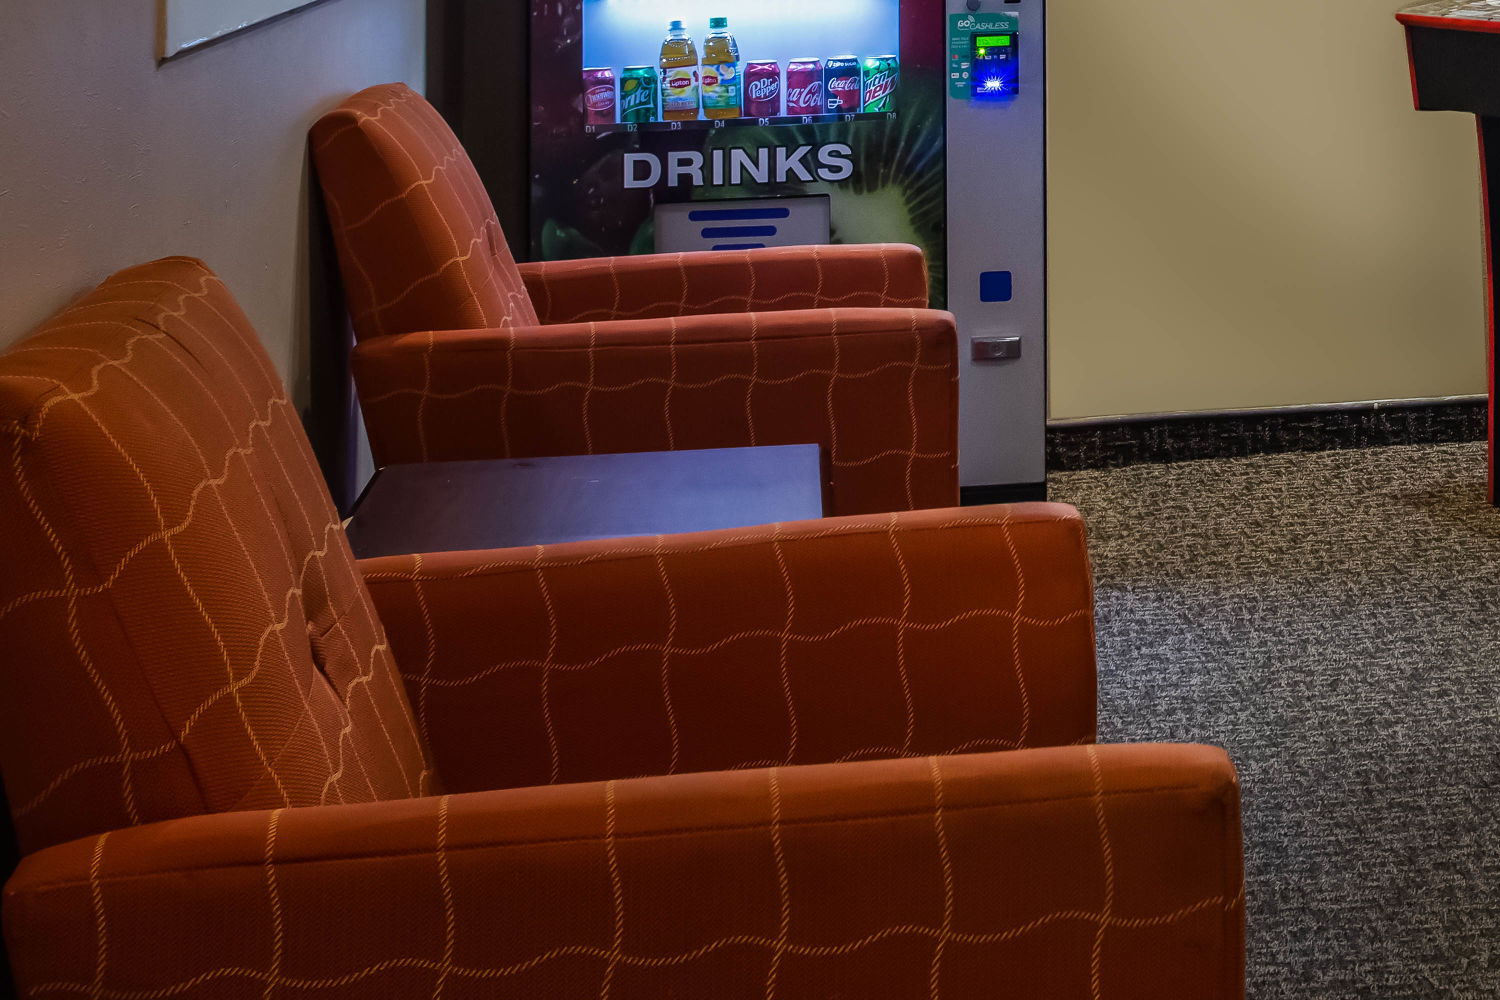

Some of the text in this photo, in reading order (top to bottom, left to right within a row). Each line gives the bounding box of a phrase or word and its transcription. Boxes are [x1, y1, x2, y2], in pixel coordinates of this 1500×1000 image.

[760, 78, 772, 89] Dr
[752, 81, 778, 99] Pepper
[802, 116, 812, 124] D6
[845, 114, 855, 122] D7
[886, 112, 897, 120] D8
[671, 122, 681, 130] D3
[714, 120, 725, 128] D4
[758, 118, 770, 126] D5
[586, 125, 596, 133] D1
[627, 124, 638, 132] D2
[623, 143, 854, 189] DRINKS
